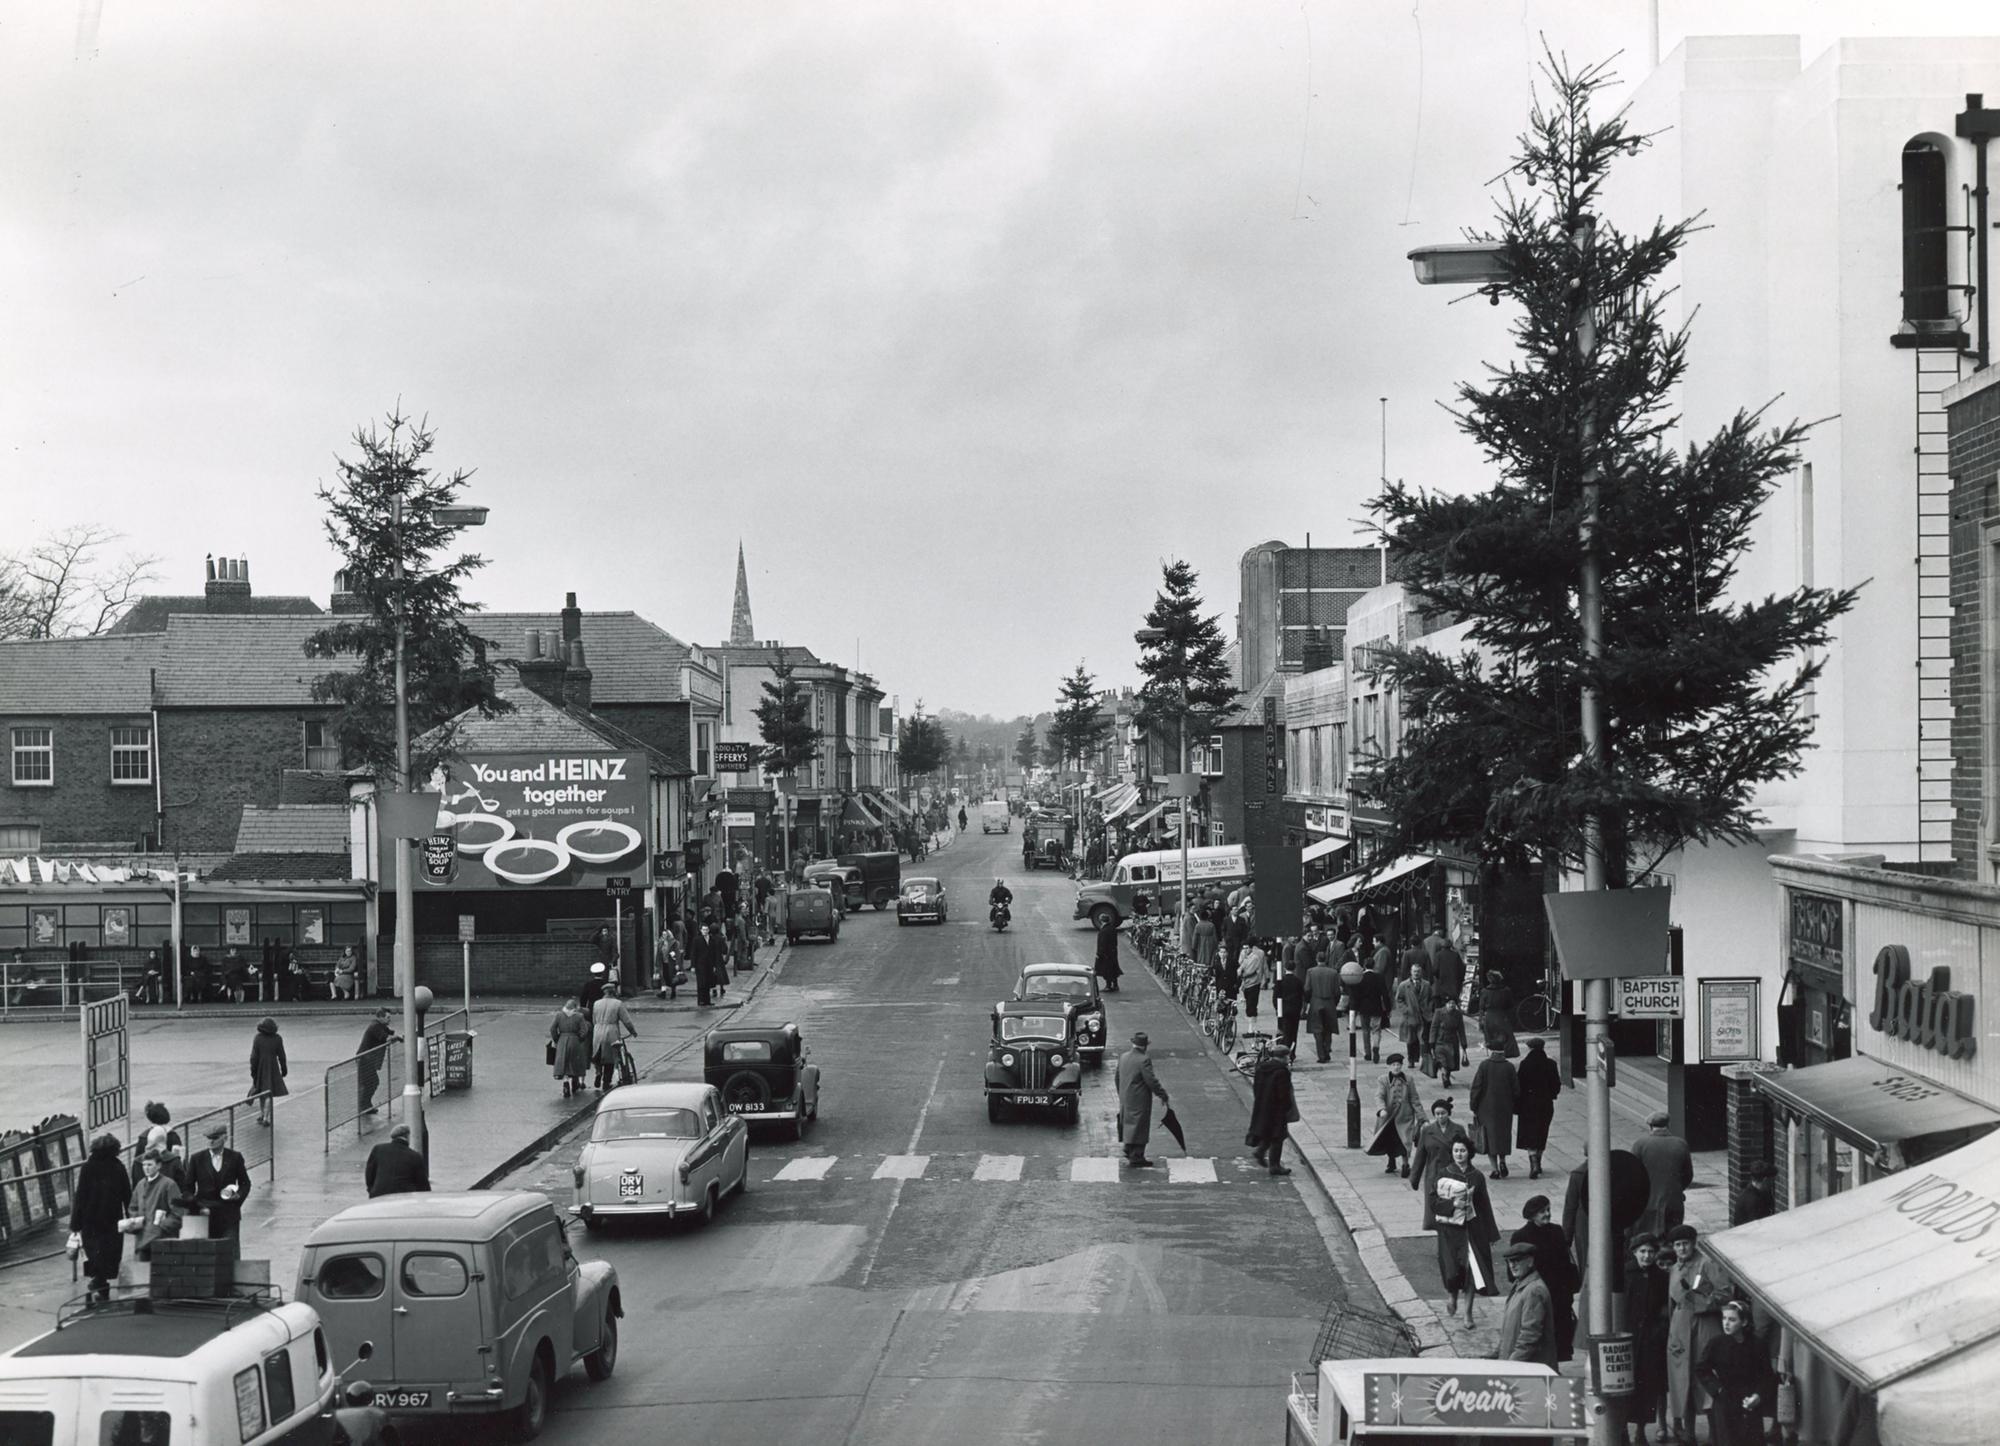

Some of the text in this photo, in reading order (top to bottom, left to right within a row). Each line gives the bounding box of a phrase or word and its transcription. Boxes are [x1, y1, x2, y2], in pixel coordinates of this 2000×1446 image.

[1265, 700, 1275, 792] CHAPMANS
[715, 753, 748, 762] EFFERYS
[471, 758, 627, 783] You and HEINZ
[523, 784, 607, 806] together
[506, 808, 522, 818] get
[532, 807, 555, 817] good
[586, 807, 599, 815] for
[427, 837, 450, 846] HEINZ
[660, 857, 673, 869] 76
[613, 879, 624, 887] NO
[606, 888, 631, 896] ENTRY
[1790, 899, 1840, 946] BISHOP
[1623, 981, 1680, 993] BAPTIST
[1624, 996, 1680, 1008] CHURCH
[447, 1040, 466, 1050] LATEST
[449, 1053, 464, 1062] BEST
[1872, 1076, 1941, 1102] SHOES
[1017, 1096, 1049, 1104] FPU 312
[745, 1103, 765, 1111] 8133
[621, 1176, 642, 1186] ORV
[621, 1186, 642, 1195] 564
[398, 1393, 429, 1407] 967
[1435, 1377, 1516, 1413] Cream
